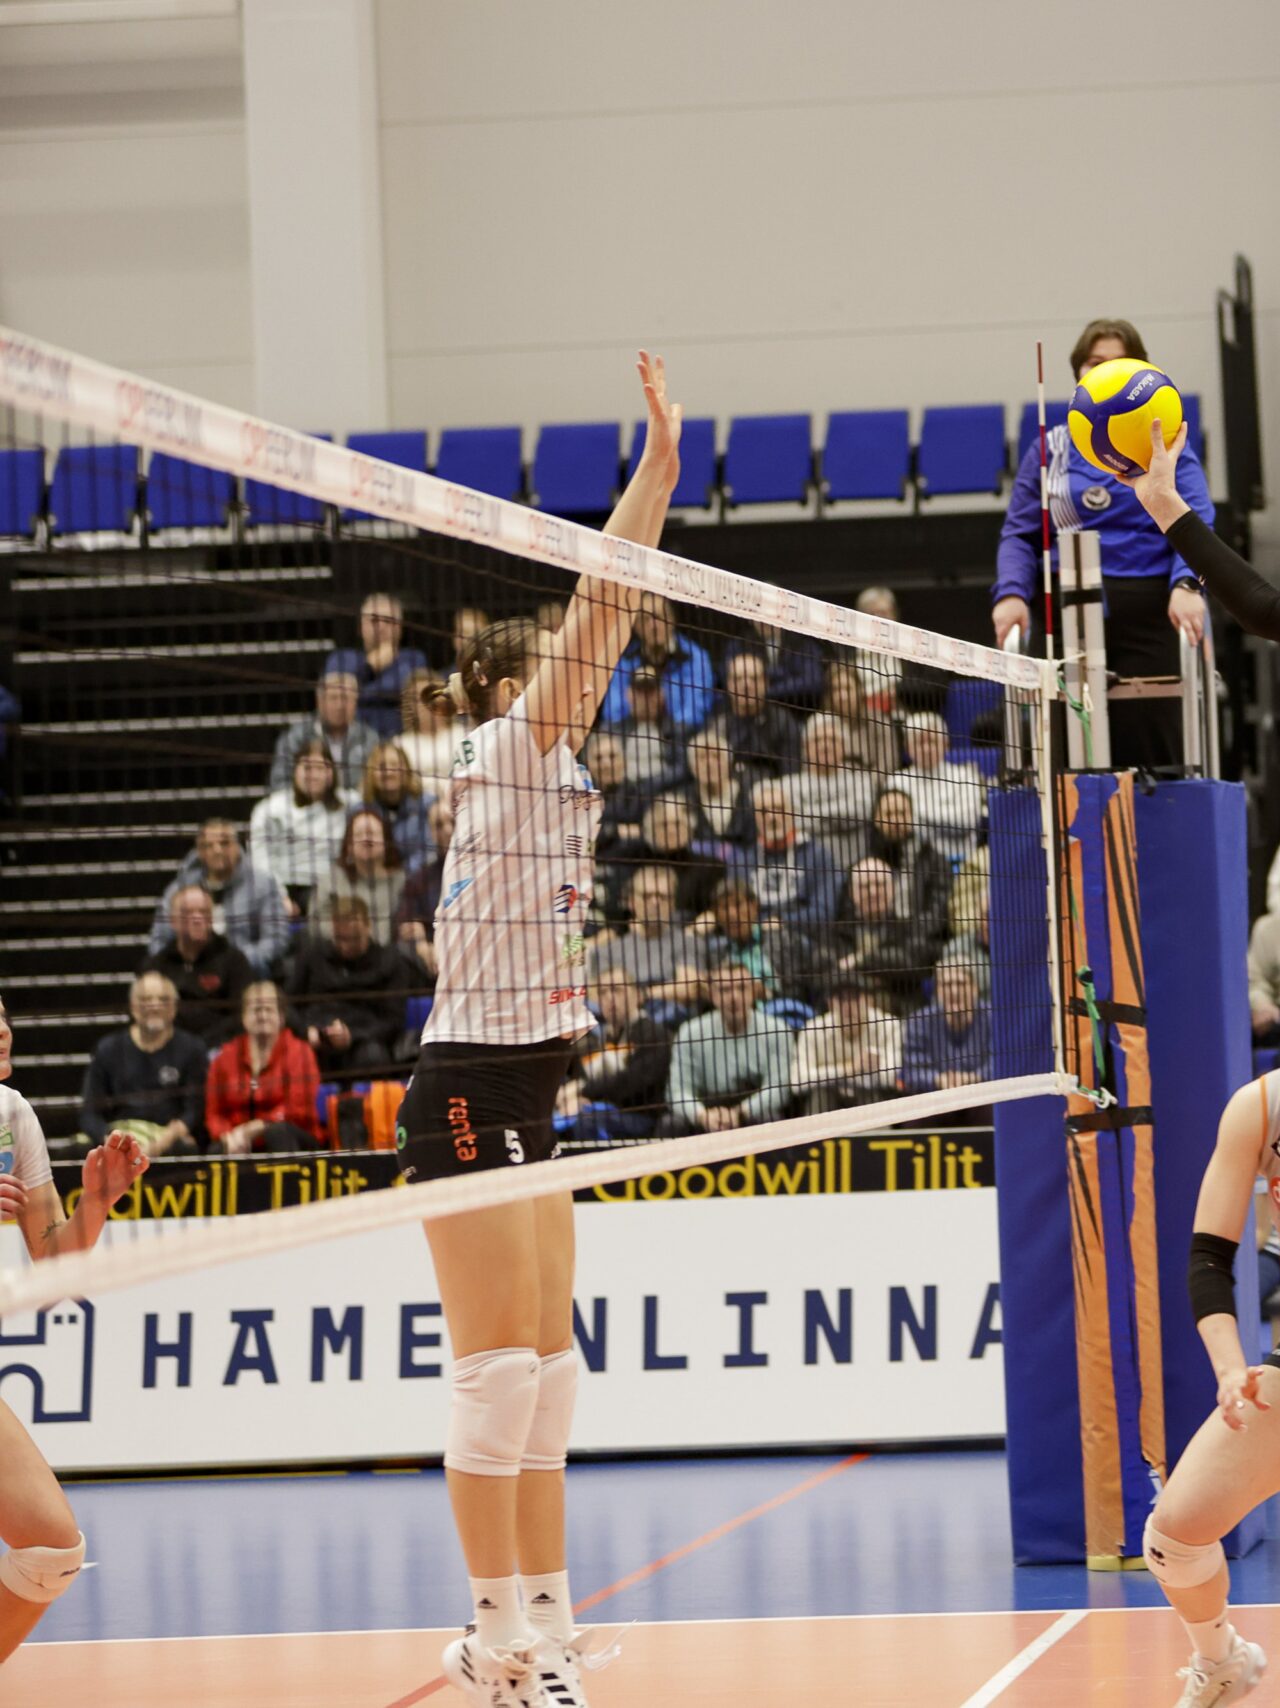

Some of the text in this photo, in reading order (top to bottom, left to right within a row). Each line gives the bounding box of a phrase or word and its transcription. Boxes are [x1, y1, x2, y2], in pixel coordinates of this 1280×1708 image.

[448, 1097, 478, 1162] renta
[504, 1129, 525, 1163] 5
[255, 1159, 368, 1210] Tilit
[868, 1136, 983, 1189] Tilit
[142, 1282, 1003, 1389] HÄMENLINNA
